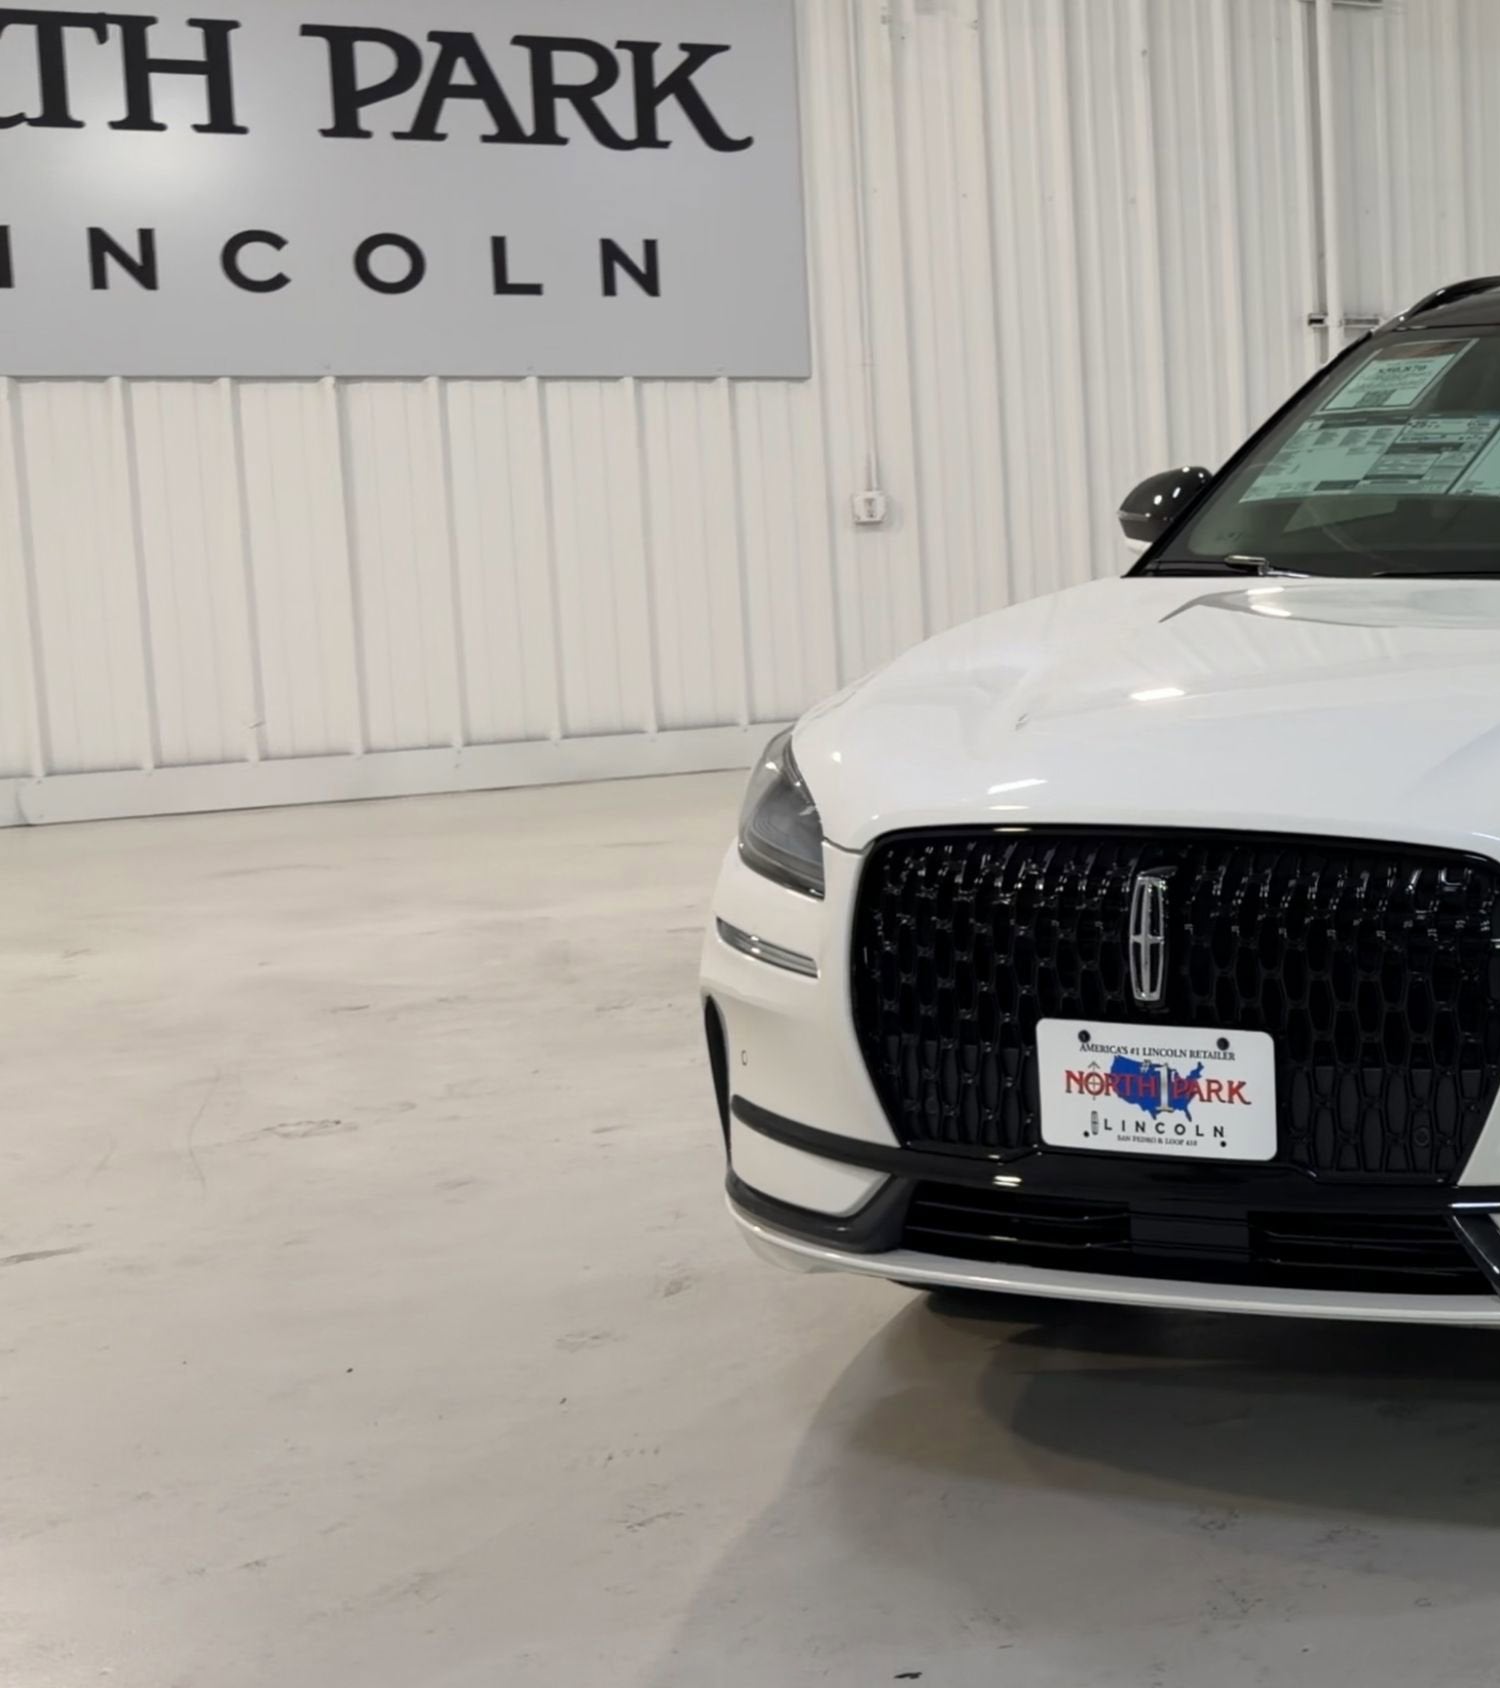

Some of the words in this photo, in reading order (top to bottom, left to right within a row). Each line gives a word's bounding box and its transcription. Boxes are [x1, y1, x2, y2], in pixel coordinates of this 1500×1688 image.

[0, 8, 250, 135] TH
[299, 23, 755, 153] PARK
[1079, 1043, 1128, 1055] AMERICA'S
[1142, 1047, 1187, 1058] LINCOLN
[1189, 1050, 1235, 1061] RETAILER
[1065, 1070, 1157, 1098] NORTH
[1172, 1077, 1252, 1105] PARK
[1103, 1118, 1225, 1138] LINCOLN
